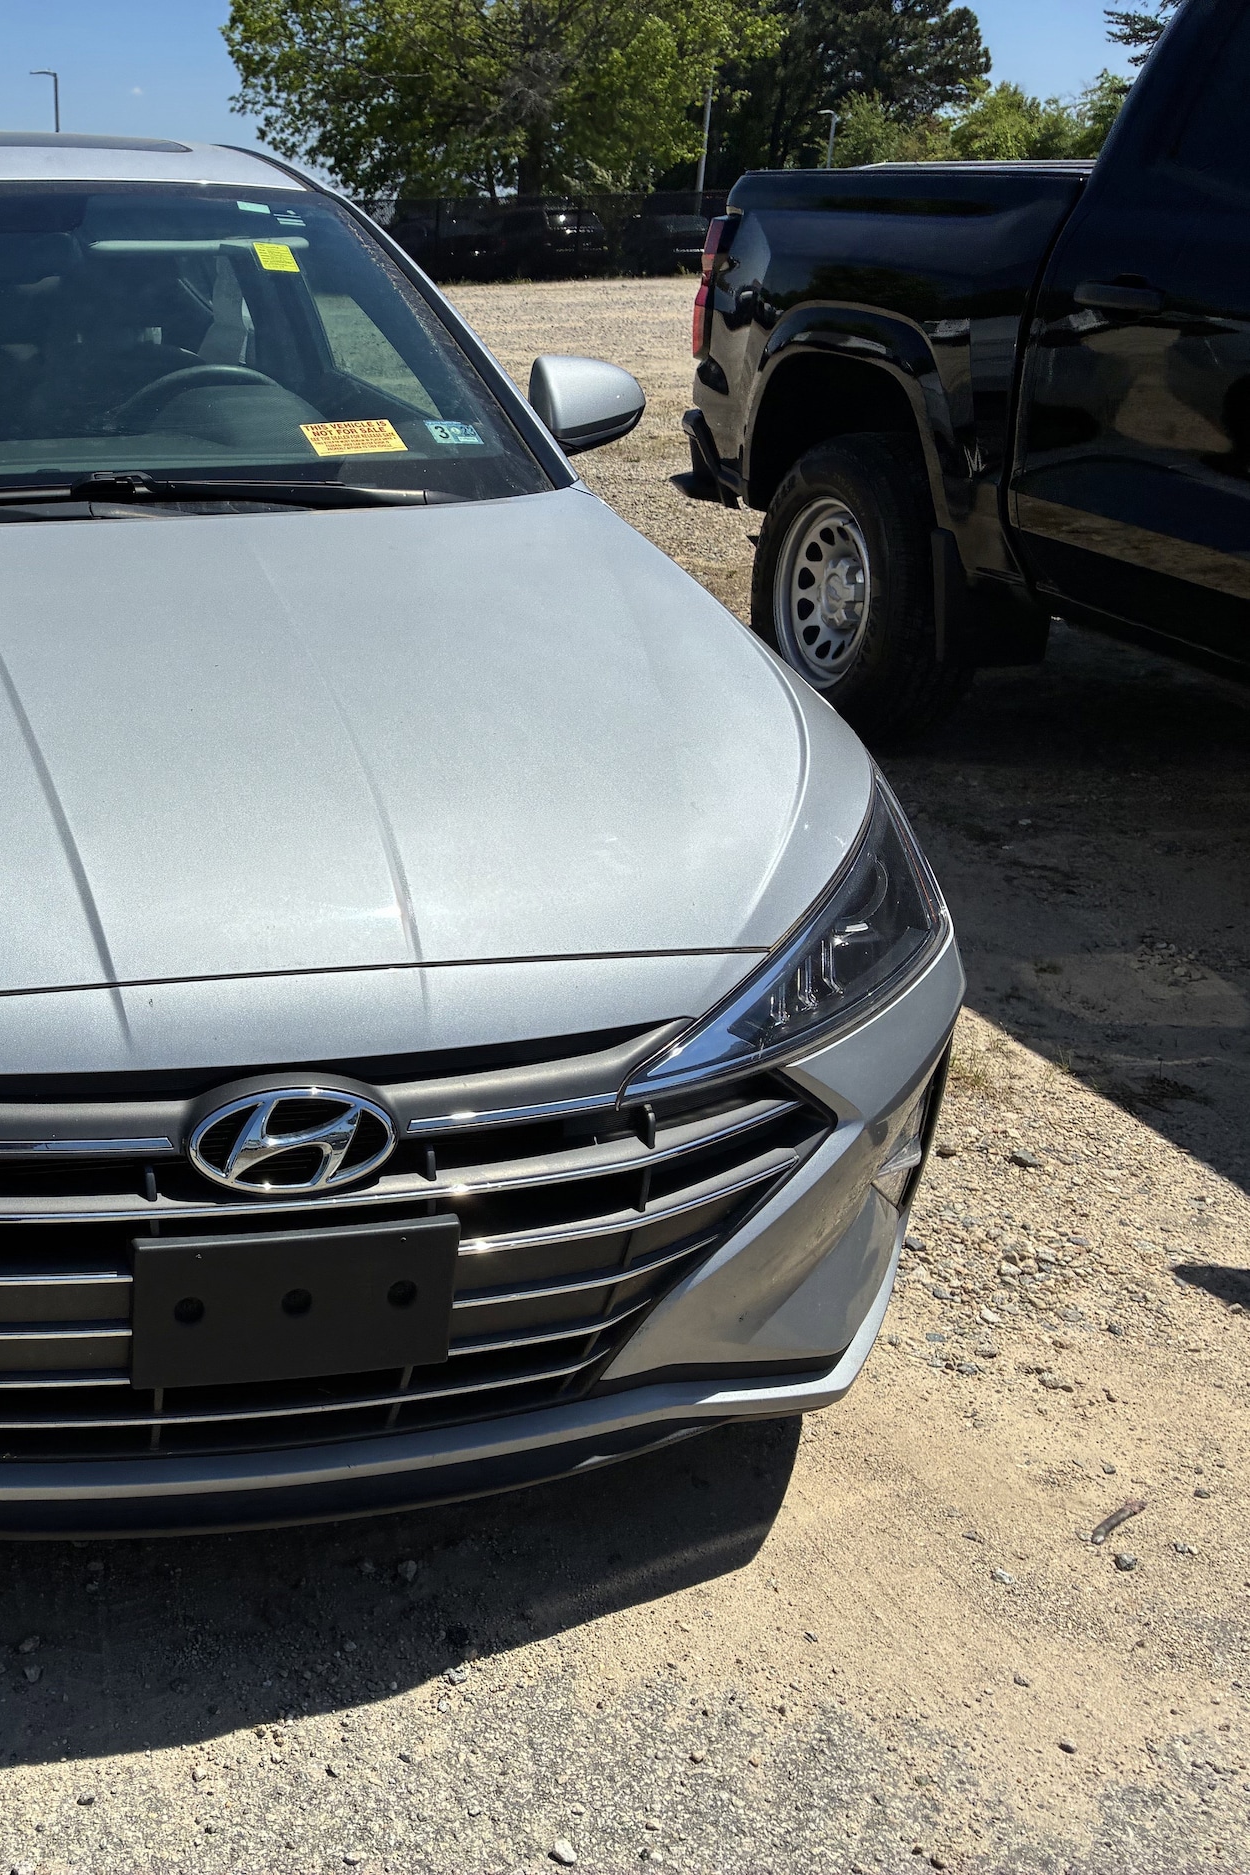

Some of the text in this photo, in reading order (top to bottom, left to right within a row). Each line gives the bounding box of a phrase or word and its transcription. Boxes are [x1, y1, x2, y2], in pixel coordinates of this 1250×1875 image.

[330, 421, 372, 429] VEHICLE
[312, 429, 333, 437] NOT
[434, 425, 450, 439] 3
